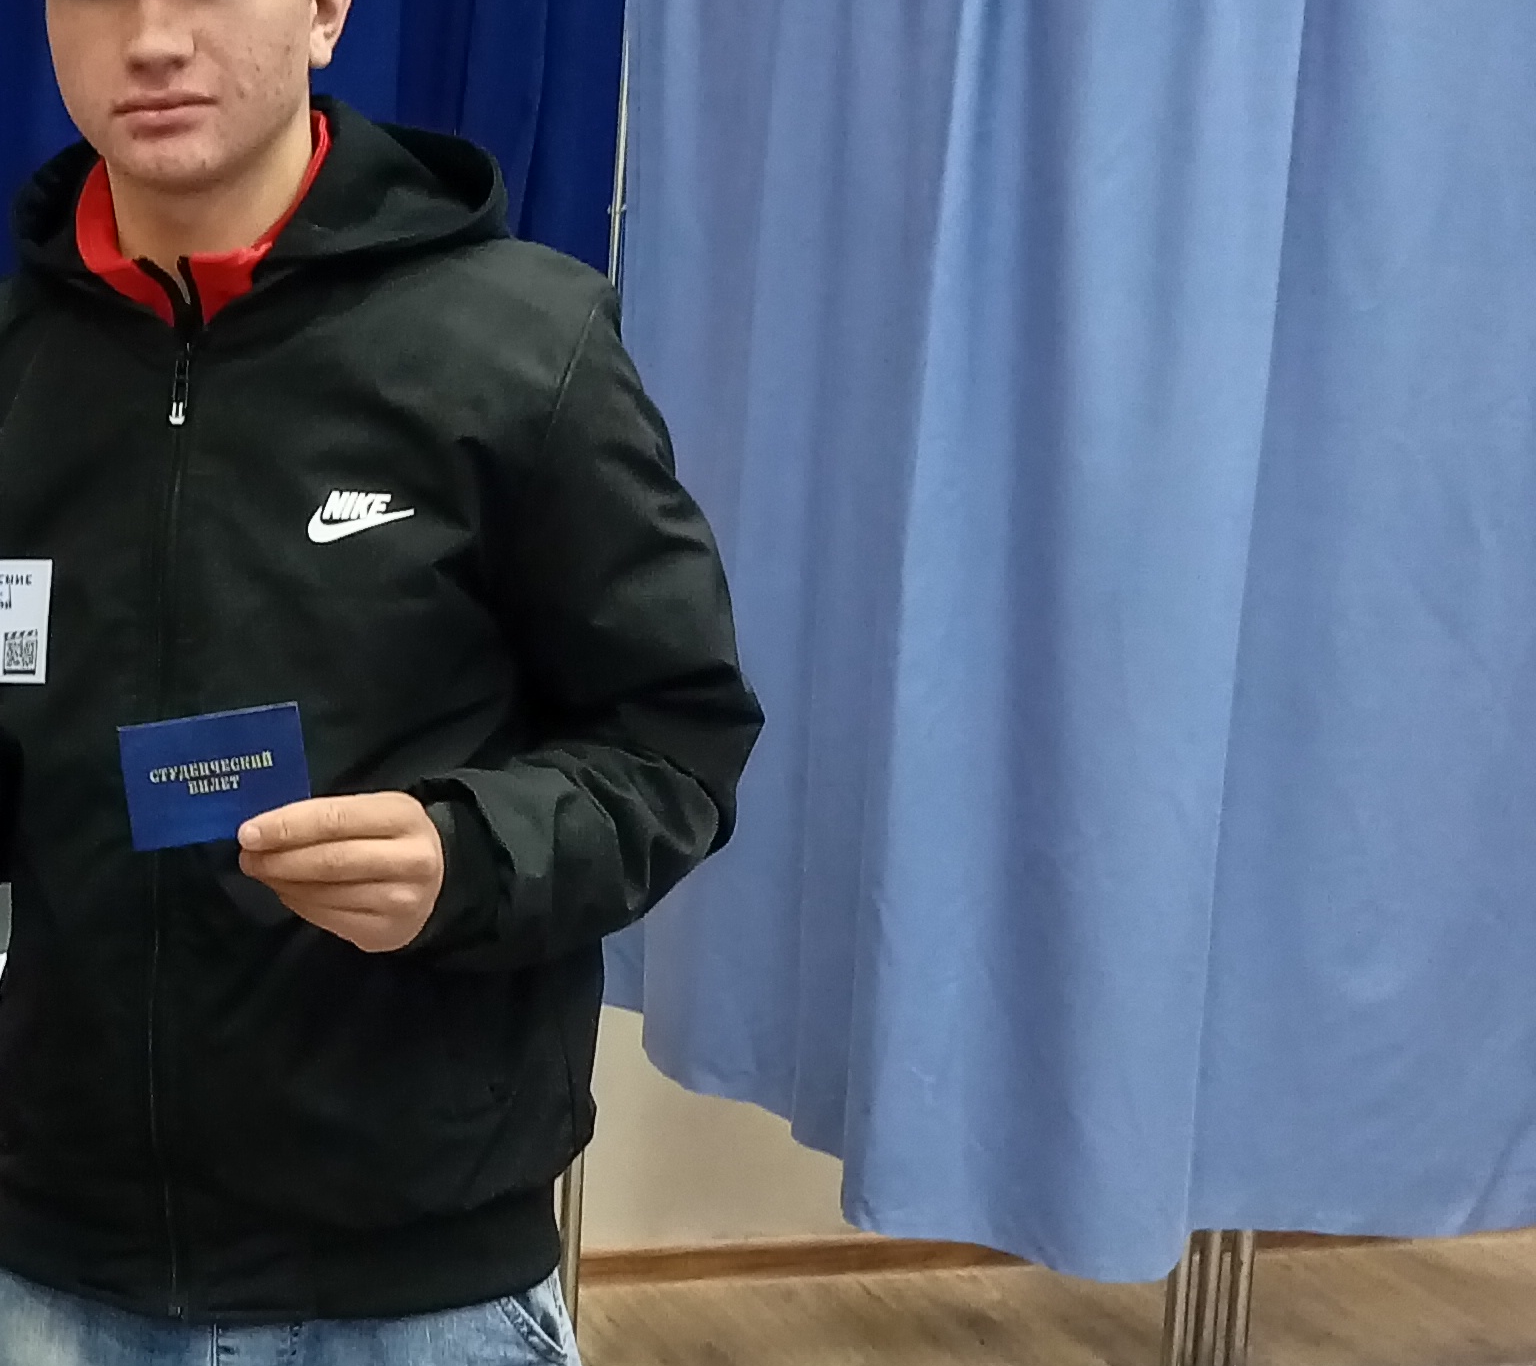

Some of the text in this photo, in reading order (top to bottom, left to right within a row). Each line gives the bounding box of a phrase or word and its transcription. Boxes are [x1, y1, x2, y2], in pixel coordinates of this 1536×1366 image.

[322, 490, 392, 520] NIKE
[149, 750, 274, 784] СТУДЕНЧЕСКИЙ
[187, 775, 240, 795] БИЛЕТ
